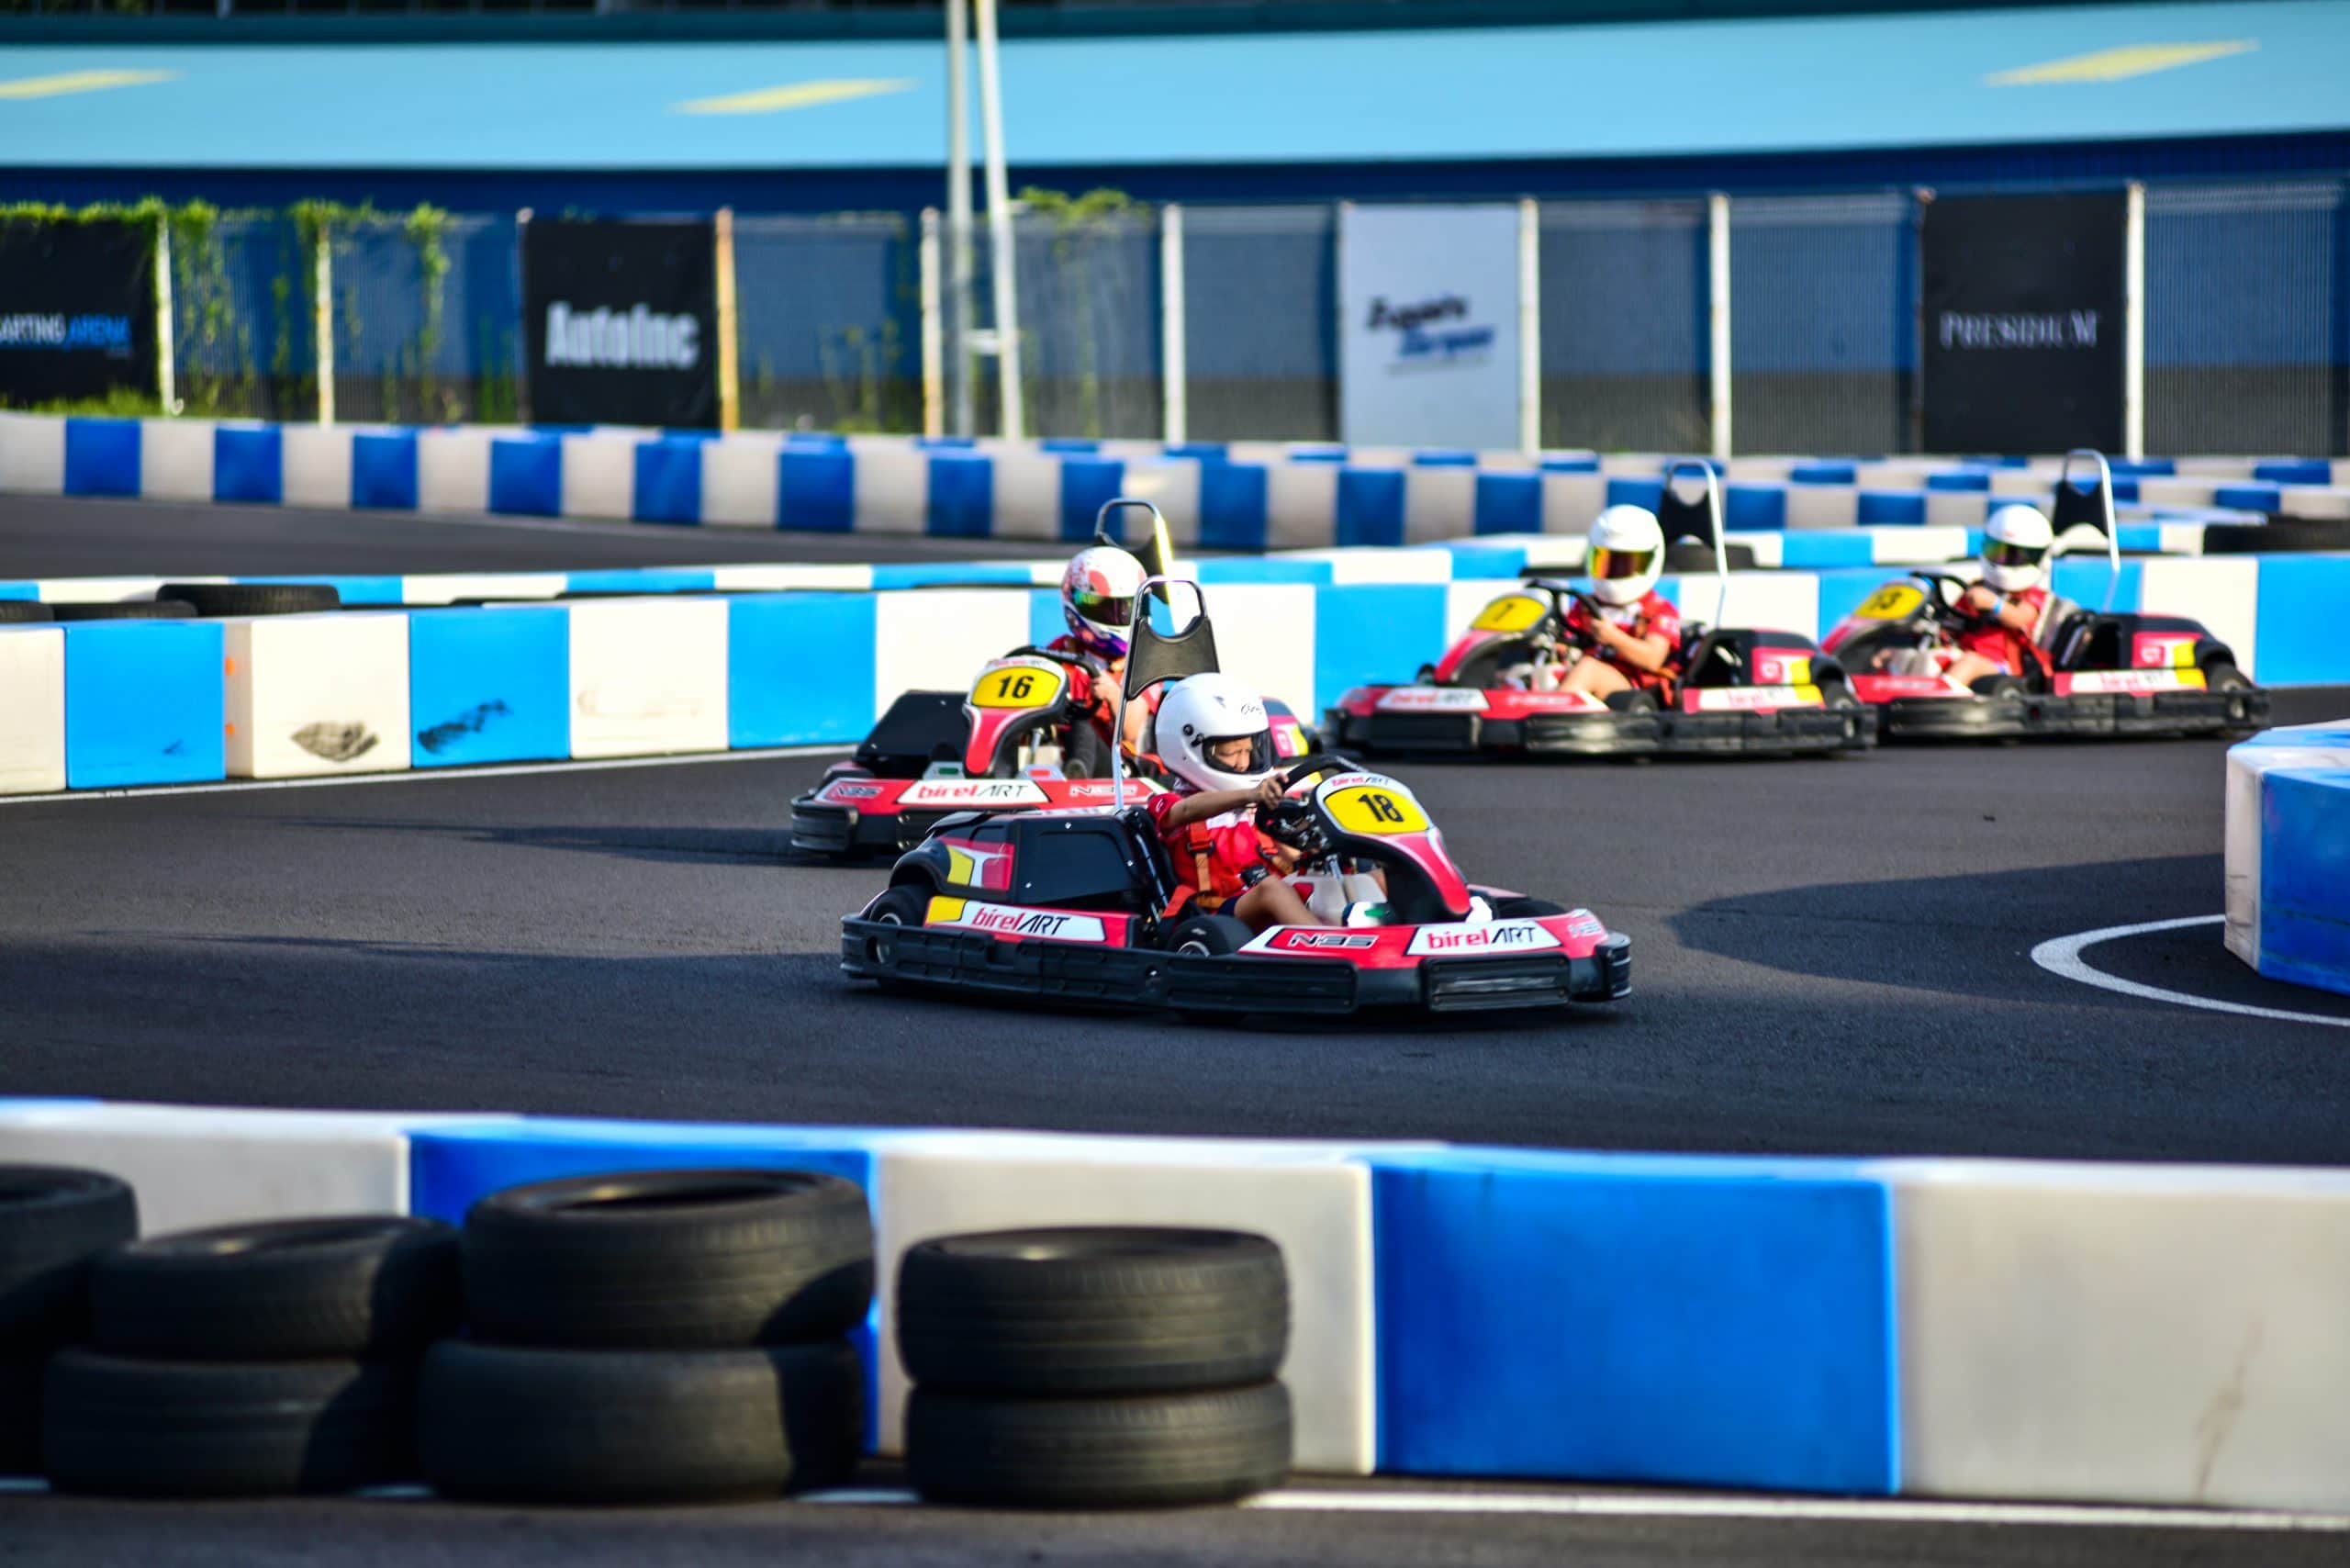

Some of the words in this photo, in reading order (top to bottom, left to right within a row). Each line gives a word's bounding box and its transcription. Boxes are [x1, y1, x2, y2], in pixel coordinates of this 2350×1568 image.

[0, 312, 66, 344] ARTING
[996, 675, 1035, 700] 16
[917, 783, 1029, 800] birelART
[1357, 793, 1405, 823] 18
[970, 906, 1072, 936] birelART
[1426, 926, 1537, 950] birelART
